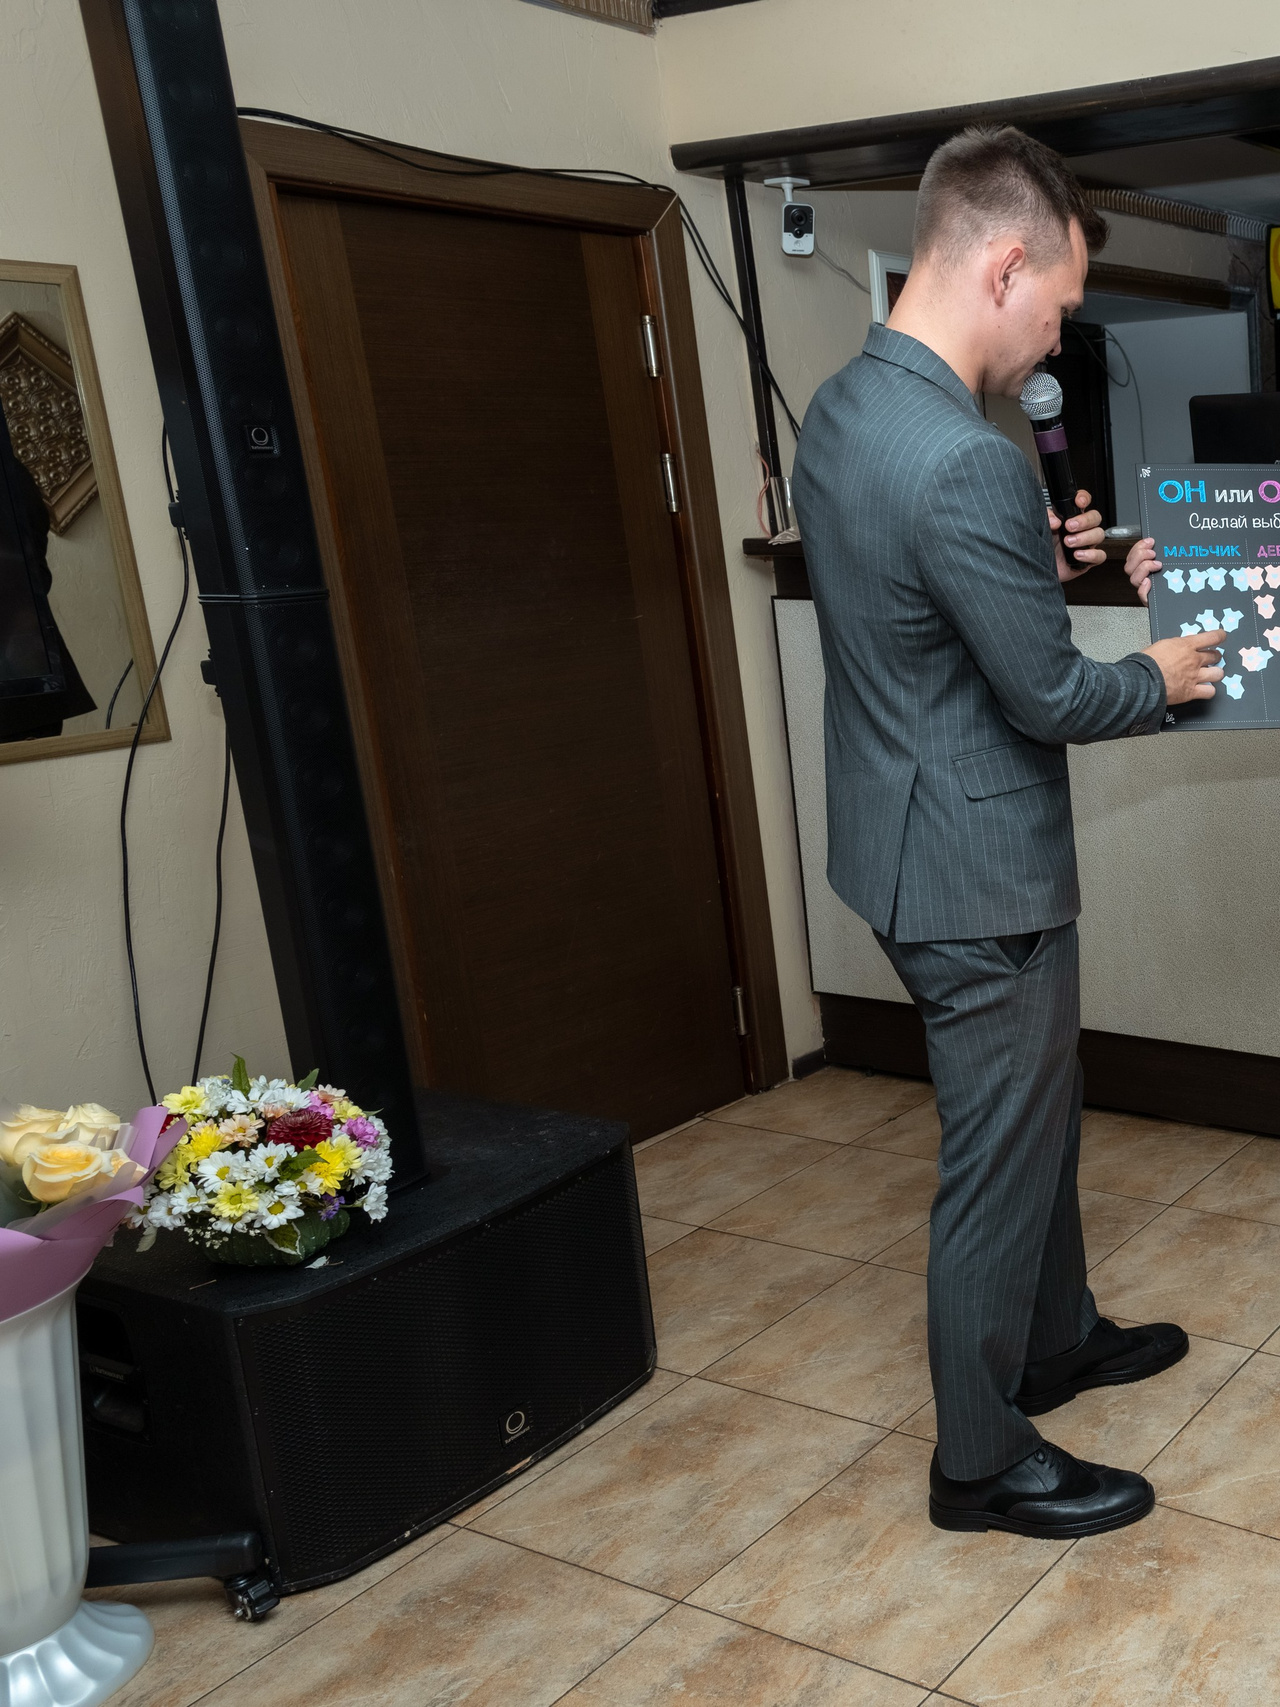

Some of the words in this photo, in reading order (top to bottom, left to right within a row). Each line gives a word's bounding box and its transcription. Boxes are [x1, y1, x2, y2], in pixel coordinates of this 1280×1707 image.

[1158, 480, 1207, 503] ОН
[1214, 489, 1254, 503] или
[1188, 513, 1248, 530] Сделай
[1163, 545, 1241, 557] МАЛЬЧИК
